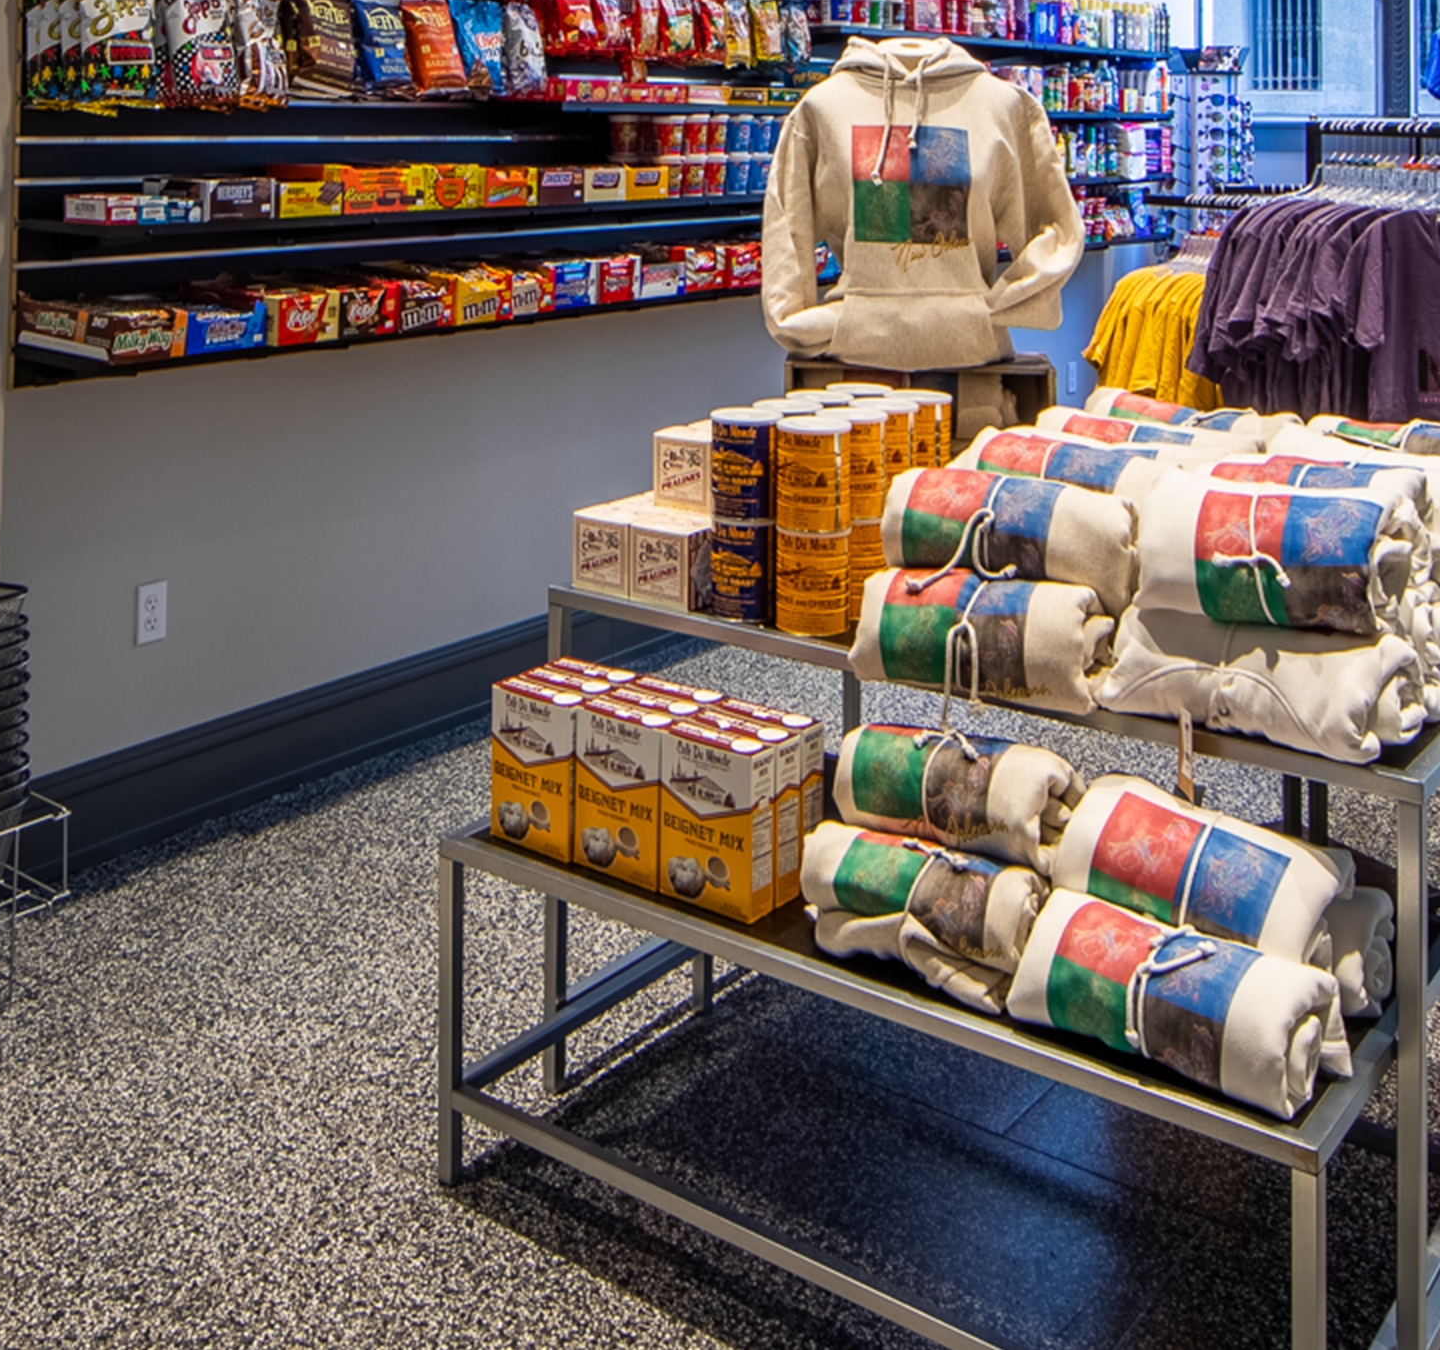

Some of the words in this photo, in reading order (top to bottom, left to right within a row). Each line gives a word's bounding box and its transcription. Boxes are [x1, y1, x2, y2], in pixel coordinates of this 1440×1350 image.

[217, 184, 253, 201] HERSHEY'S
[662, 472, 701, 491] PRALINES
[581, 553, 619, 571] PRALINES
[638, 566, 678, 585] PRALINES
[493, 759, 537, 788] BEIGNET
[540, 777, 563, 797] MIX
[578, 784, 626, 815] BEIGNET
[629, 802, 653, 824] MIX
[663, 811, 715, 844] BEIGNET
[719, 832, 745, 853] MIX
